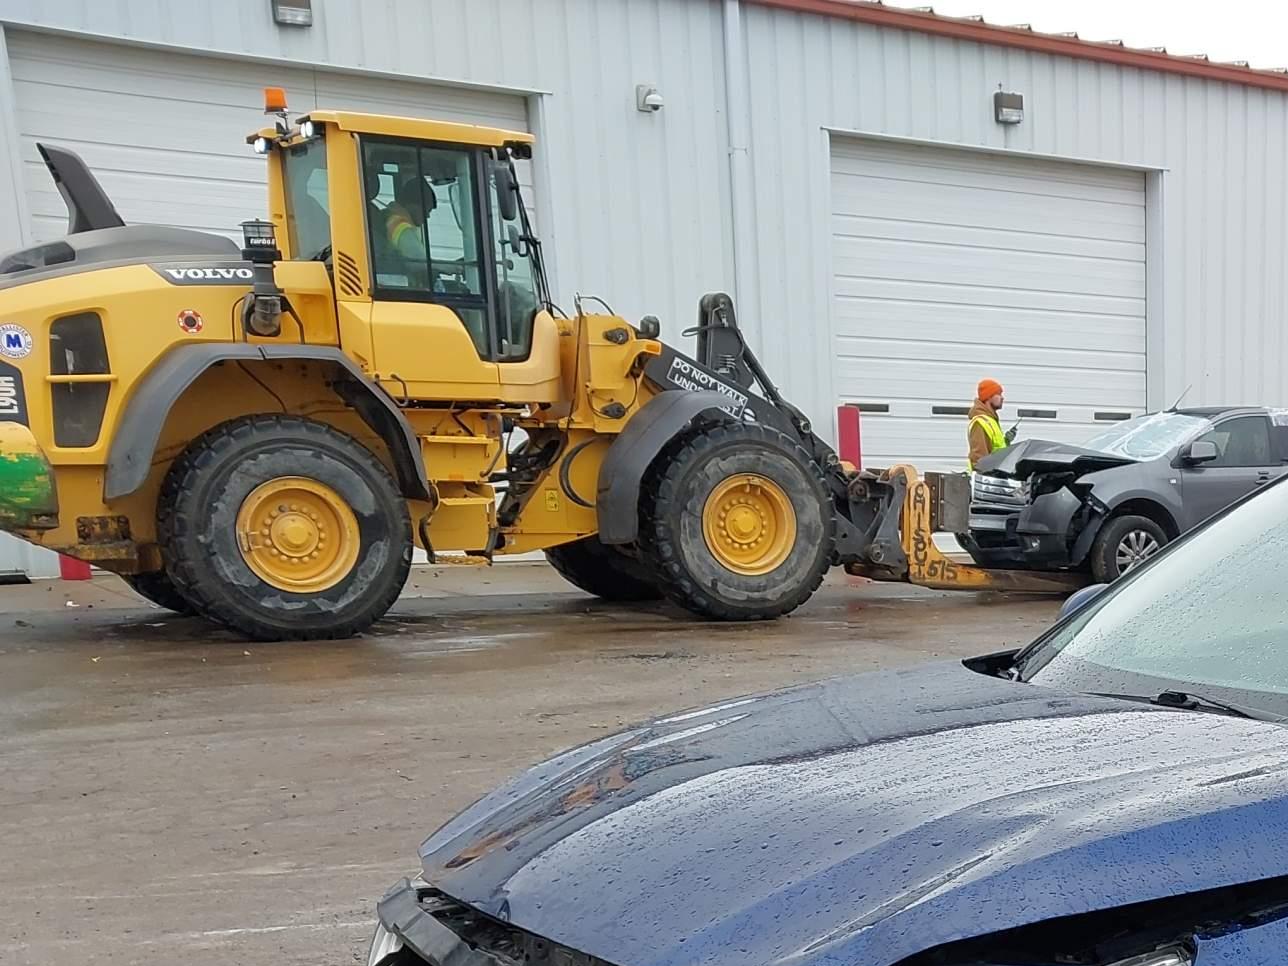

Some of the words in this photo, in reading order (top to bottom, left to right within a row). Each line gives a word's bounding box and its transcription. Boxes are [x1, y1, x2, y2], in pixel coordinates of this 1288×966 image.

[164, 268, 253, 279] VOLVO
[5, 333, 23, 349] M
[673, 357, 690, 374] DO
[691, 369, 716, 388] NOT
[717, 382, 745, 406] WALK
